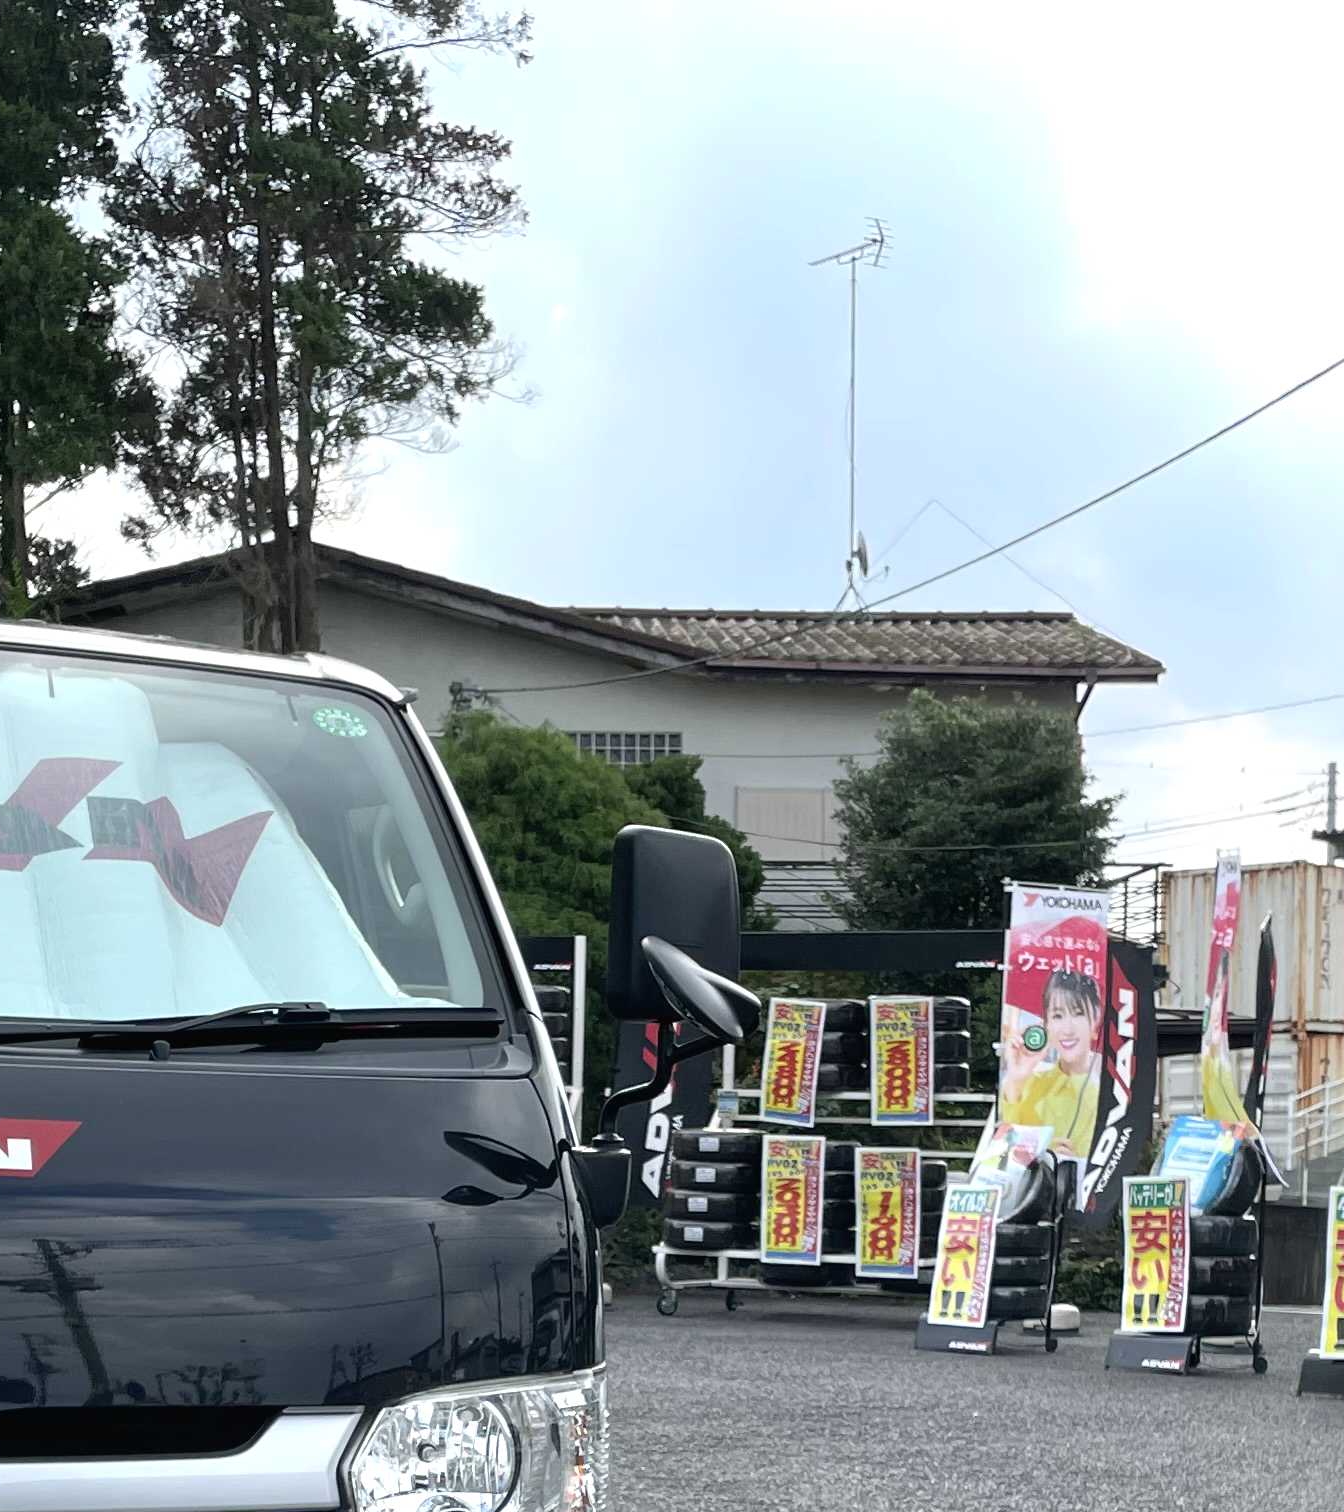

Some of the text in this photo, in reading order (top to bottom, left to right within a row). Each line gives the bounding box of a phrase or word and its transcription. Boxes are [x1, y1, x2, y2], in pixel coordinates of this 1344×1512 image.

[1041, 896, 1103, 911] YOKOHAMA
[1081, 988, 1134, 1214] ADVAN
[1095, 1127, 1132, 1194] YOKOHAMA
[1142, 1358, 1181, 1370] ADVAN
